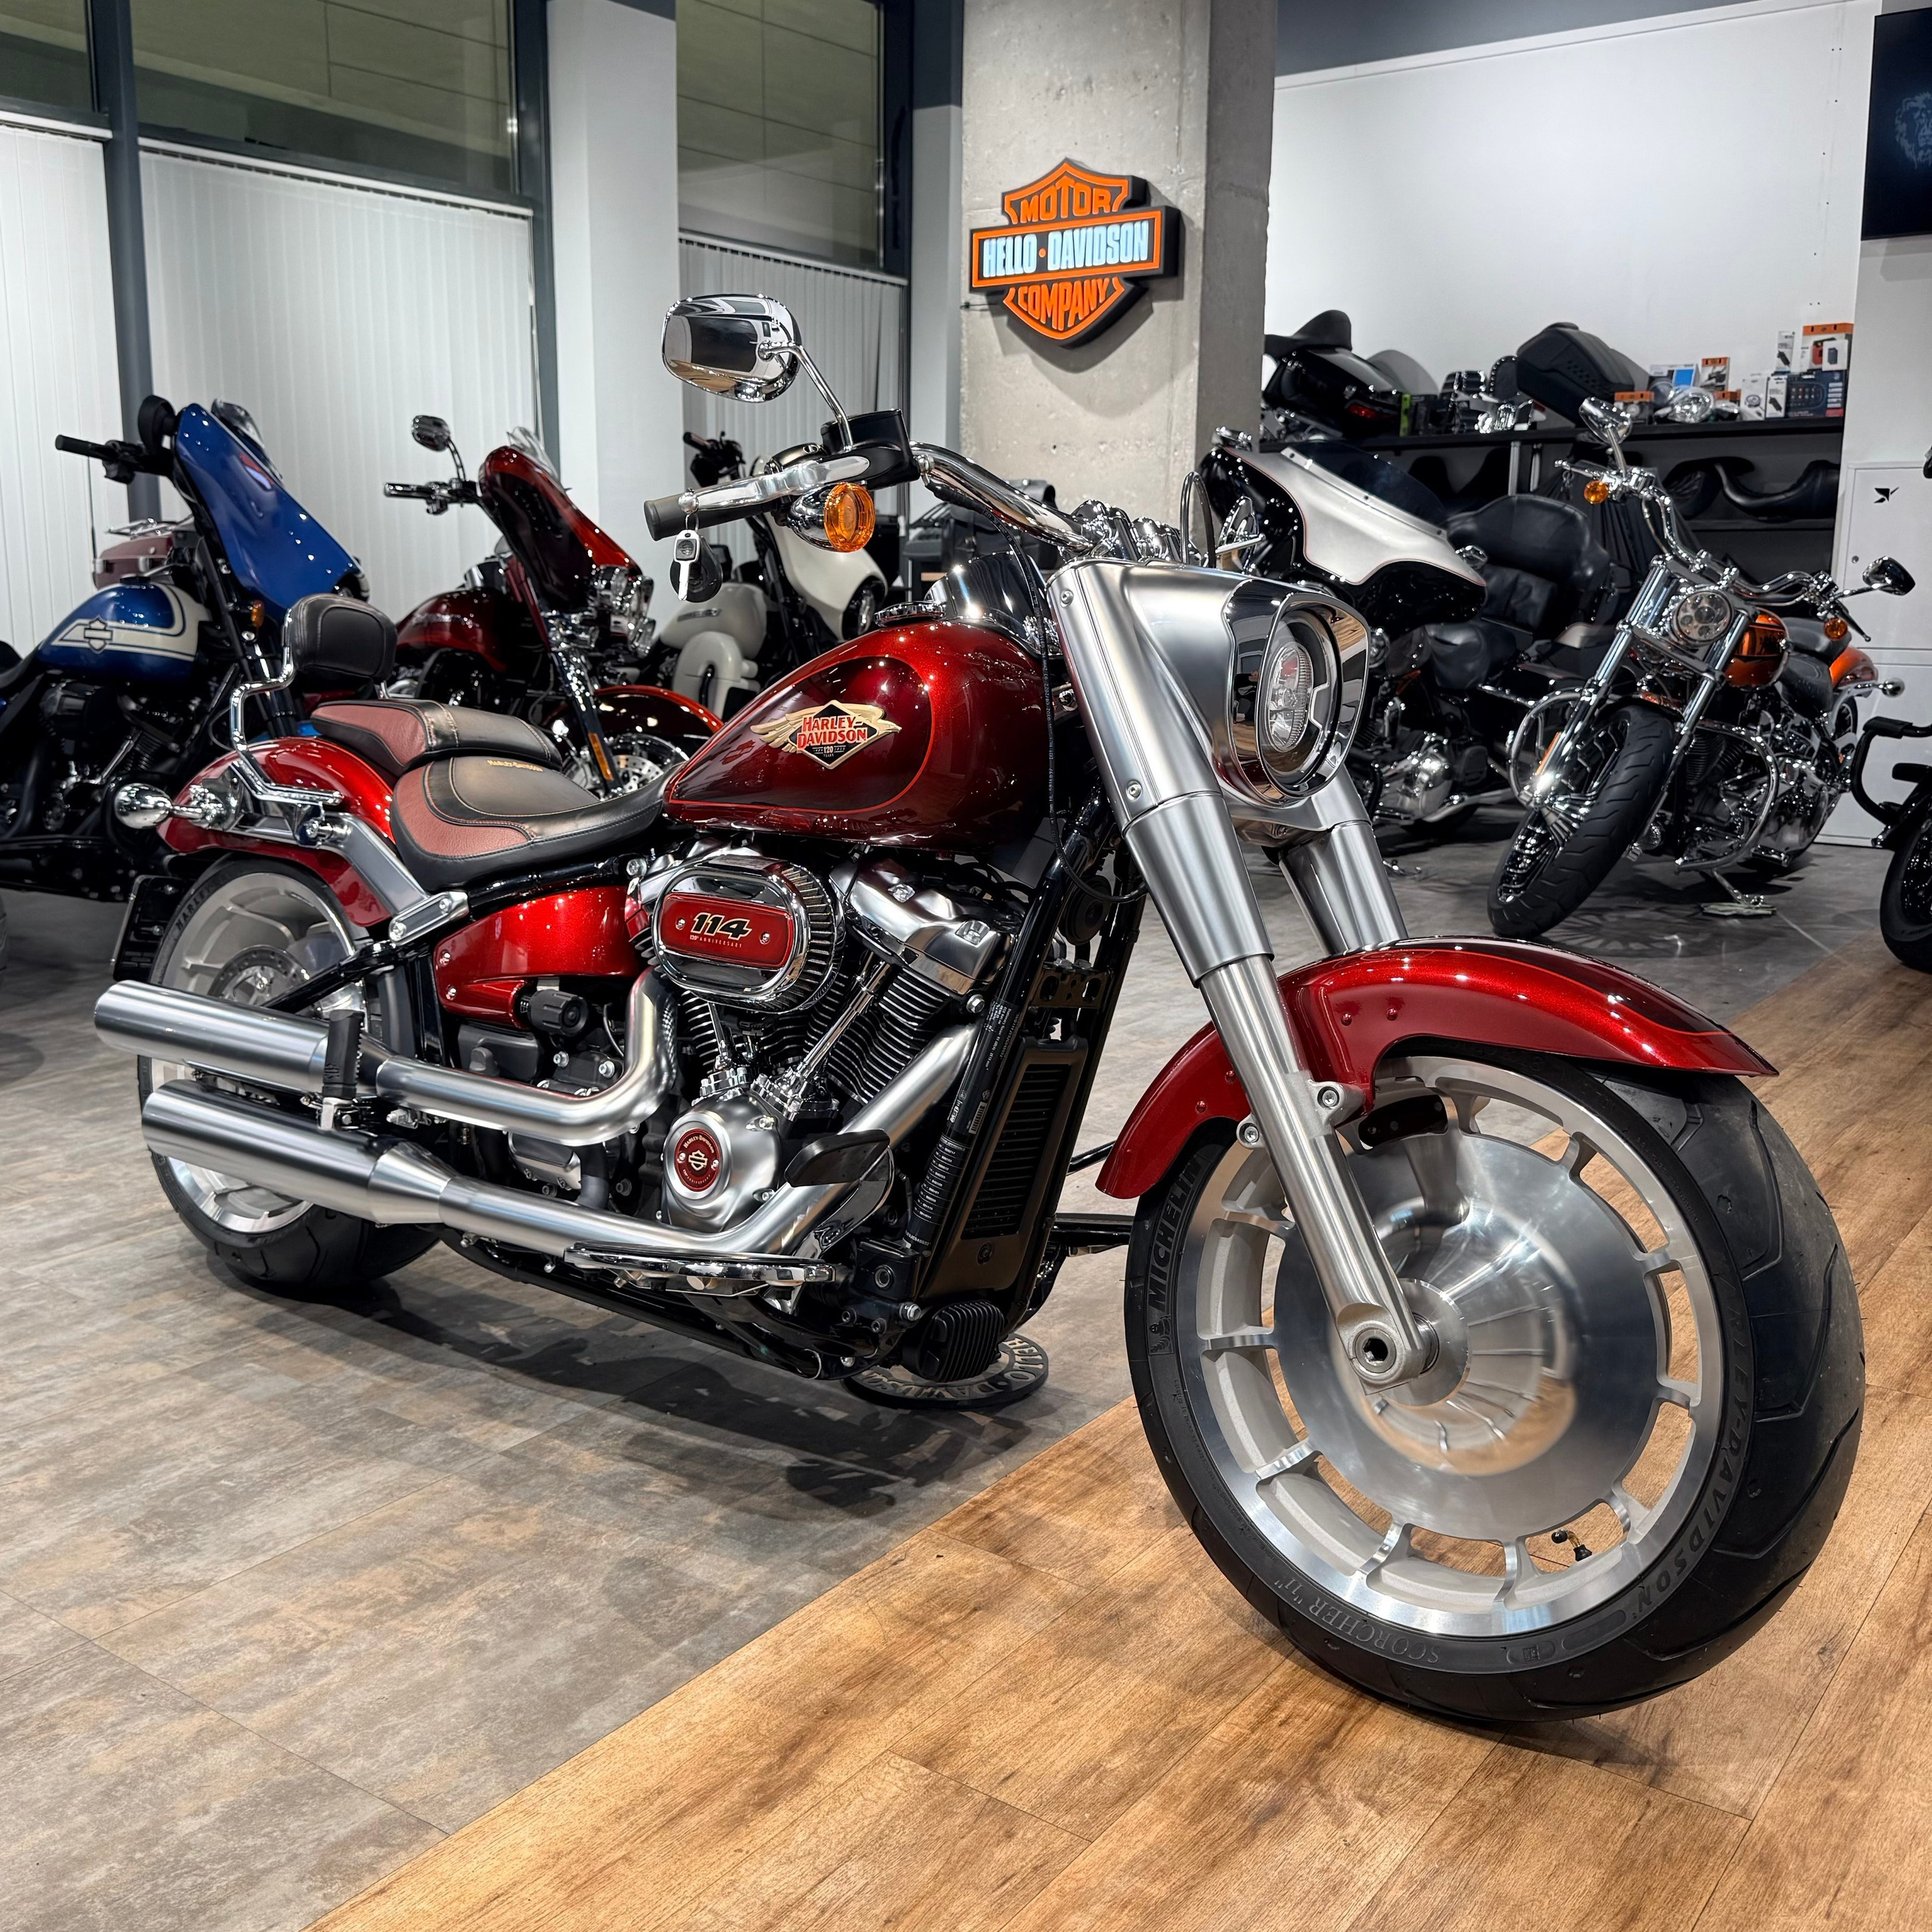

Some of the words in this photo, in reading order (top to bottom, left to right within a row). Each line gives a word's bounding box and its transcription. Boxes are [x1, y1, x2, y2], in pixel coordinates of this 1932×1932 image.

[1020, 175, 1112, 223] MOTOR
[983, 234, 1038, 278] HELLO
[1048, 220, 1149, 271] DAVIDSON
[1018, 277, 1111, 331] COMPANY
[797, 728, 868, 749] DAVIDSON
[802, 715, 863, 732] HARLEY-
[823, 746, 834, 754] 120
[691, 912, 752, 940] 114
[1149, 1157, 1203, 1313] MICHELIN
[1309, 1595, 1439, 1665] SCORCHER
